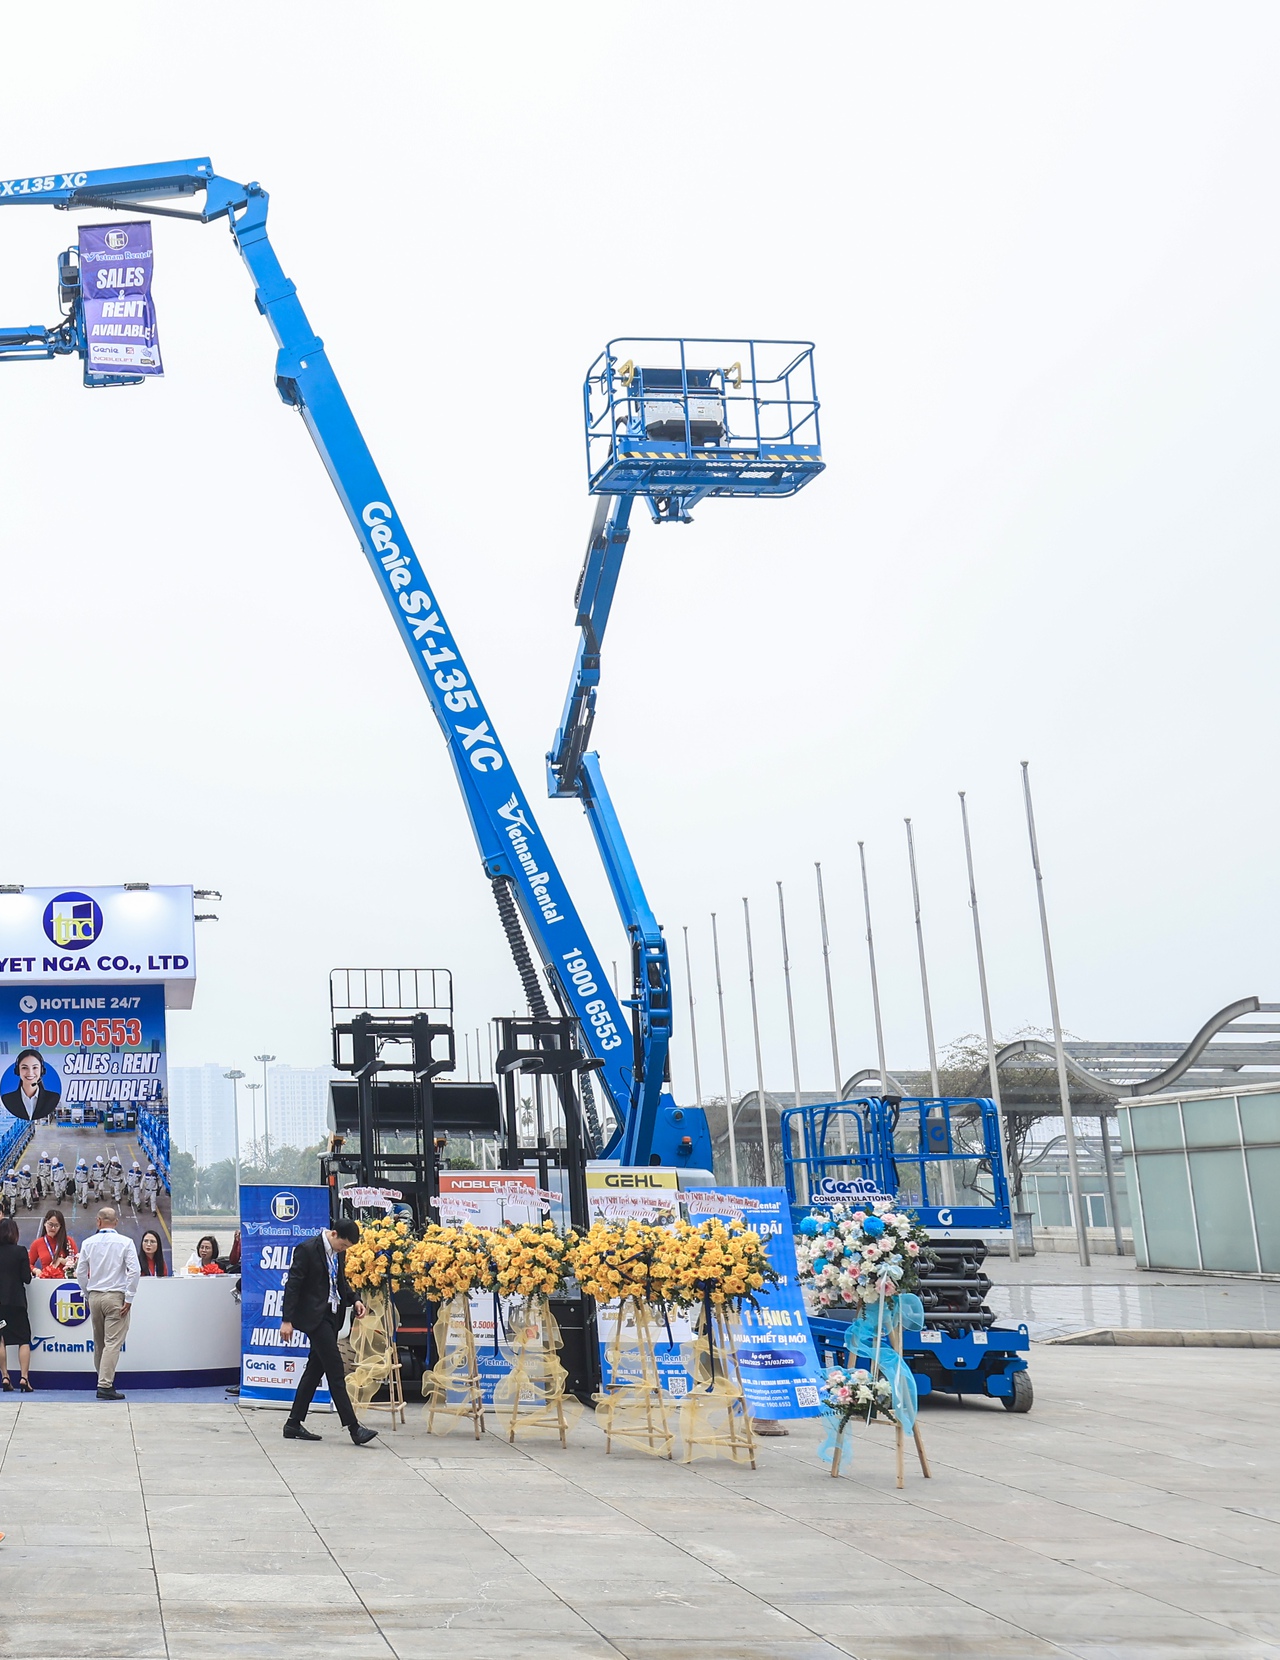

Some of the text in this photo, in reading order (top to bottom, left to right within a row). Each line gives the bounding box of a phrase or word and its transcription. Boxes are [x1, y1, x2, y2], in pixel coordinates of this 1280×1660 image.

[59, 172, 88, 189] XC
[80, 251, 124, 262] Vietnam
[96, 267, 145, 289] SALES
[118, 289, 125, 301] &
[101, 300, 147, 318] RENT
[93, 345, 119, 354] Genie
[361, 501, 504, 774] Genie SX-135 XC
[42, 956, 91, 972] NGA
[97, 955, 142, 974] CO.,
[148, 954, 189, 971] LTD
[40, 997, 141, 1010] HOTLINE 24/7
[561, 946, 623, 1052] 1900 6553
[17, 1018, 142, 1048] 1900.6553
[63, 1052, 161, 1075] SALES & RENT
[451, 1180, 523, 1189] NOBLELIFT
[604, 1174, 663, 1188] GEHL
[821, 1178, 877, 1194] Genie
[727, 1194, 743, 1204] Vietnam
[813, 1194, 893, 1202] CONGRATULATIONS
[604, 1203, 628, 1216] Chúc
[690, 1200, 714, 1213] Chúc
[242, 1221, 291, 1236] Vietnam
[760, 1220, 782, 1234] ĐÃI
[744, 1310, 753, 1326] 1
[793, 1309, 803, 1326] 1
[29, 1335, 84, 1353] Vietnam
[751, 1331, 776, 1343] THIẾT
[777, 1335, 788, 1345] BỊ
[788, 1332, 807, 1344] MỚI
[245, 1358, 277, 1371] Genie
[246, 1375, 294, 1384] NOBLELIFT
